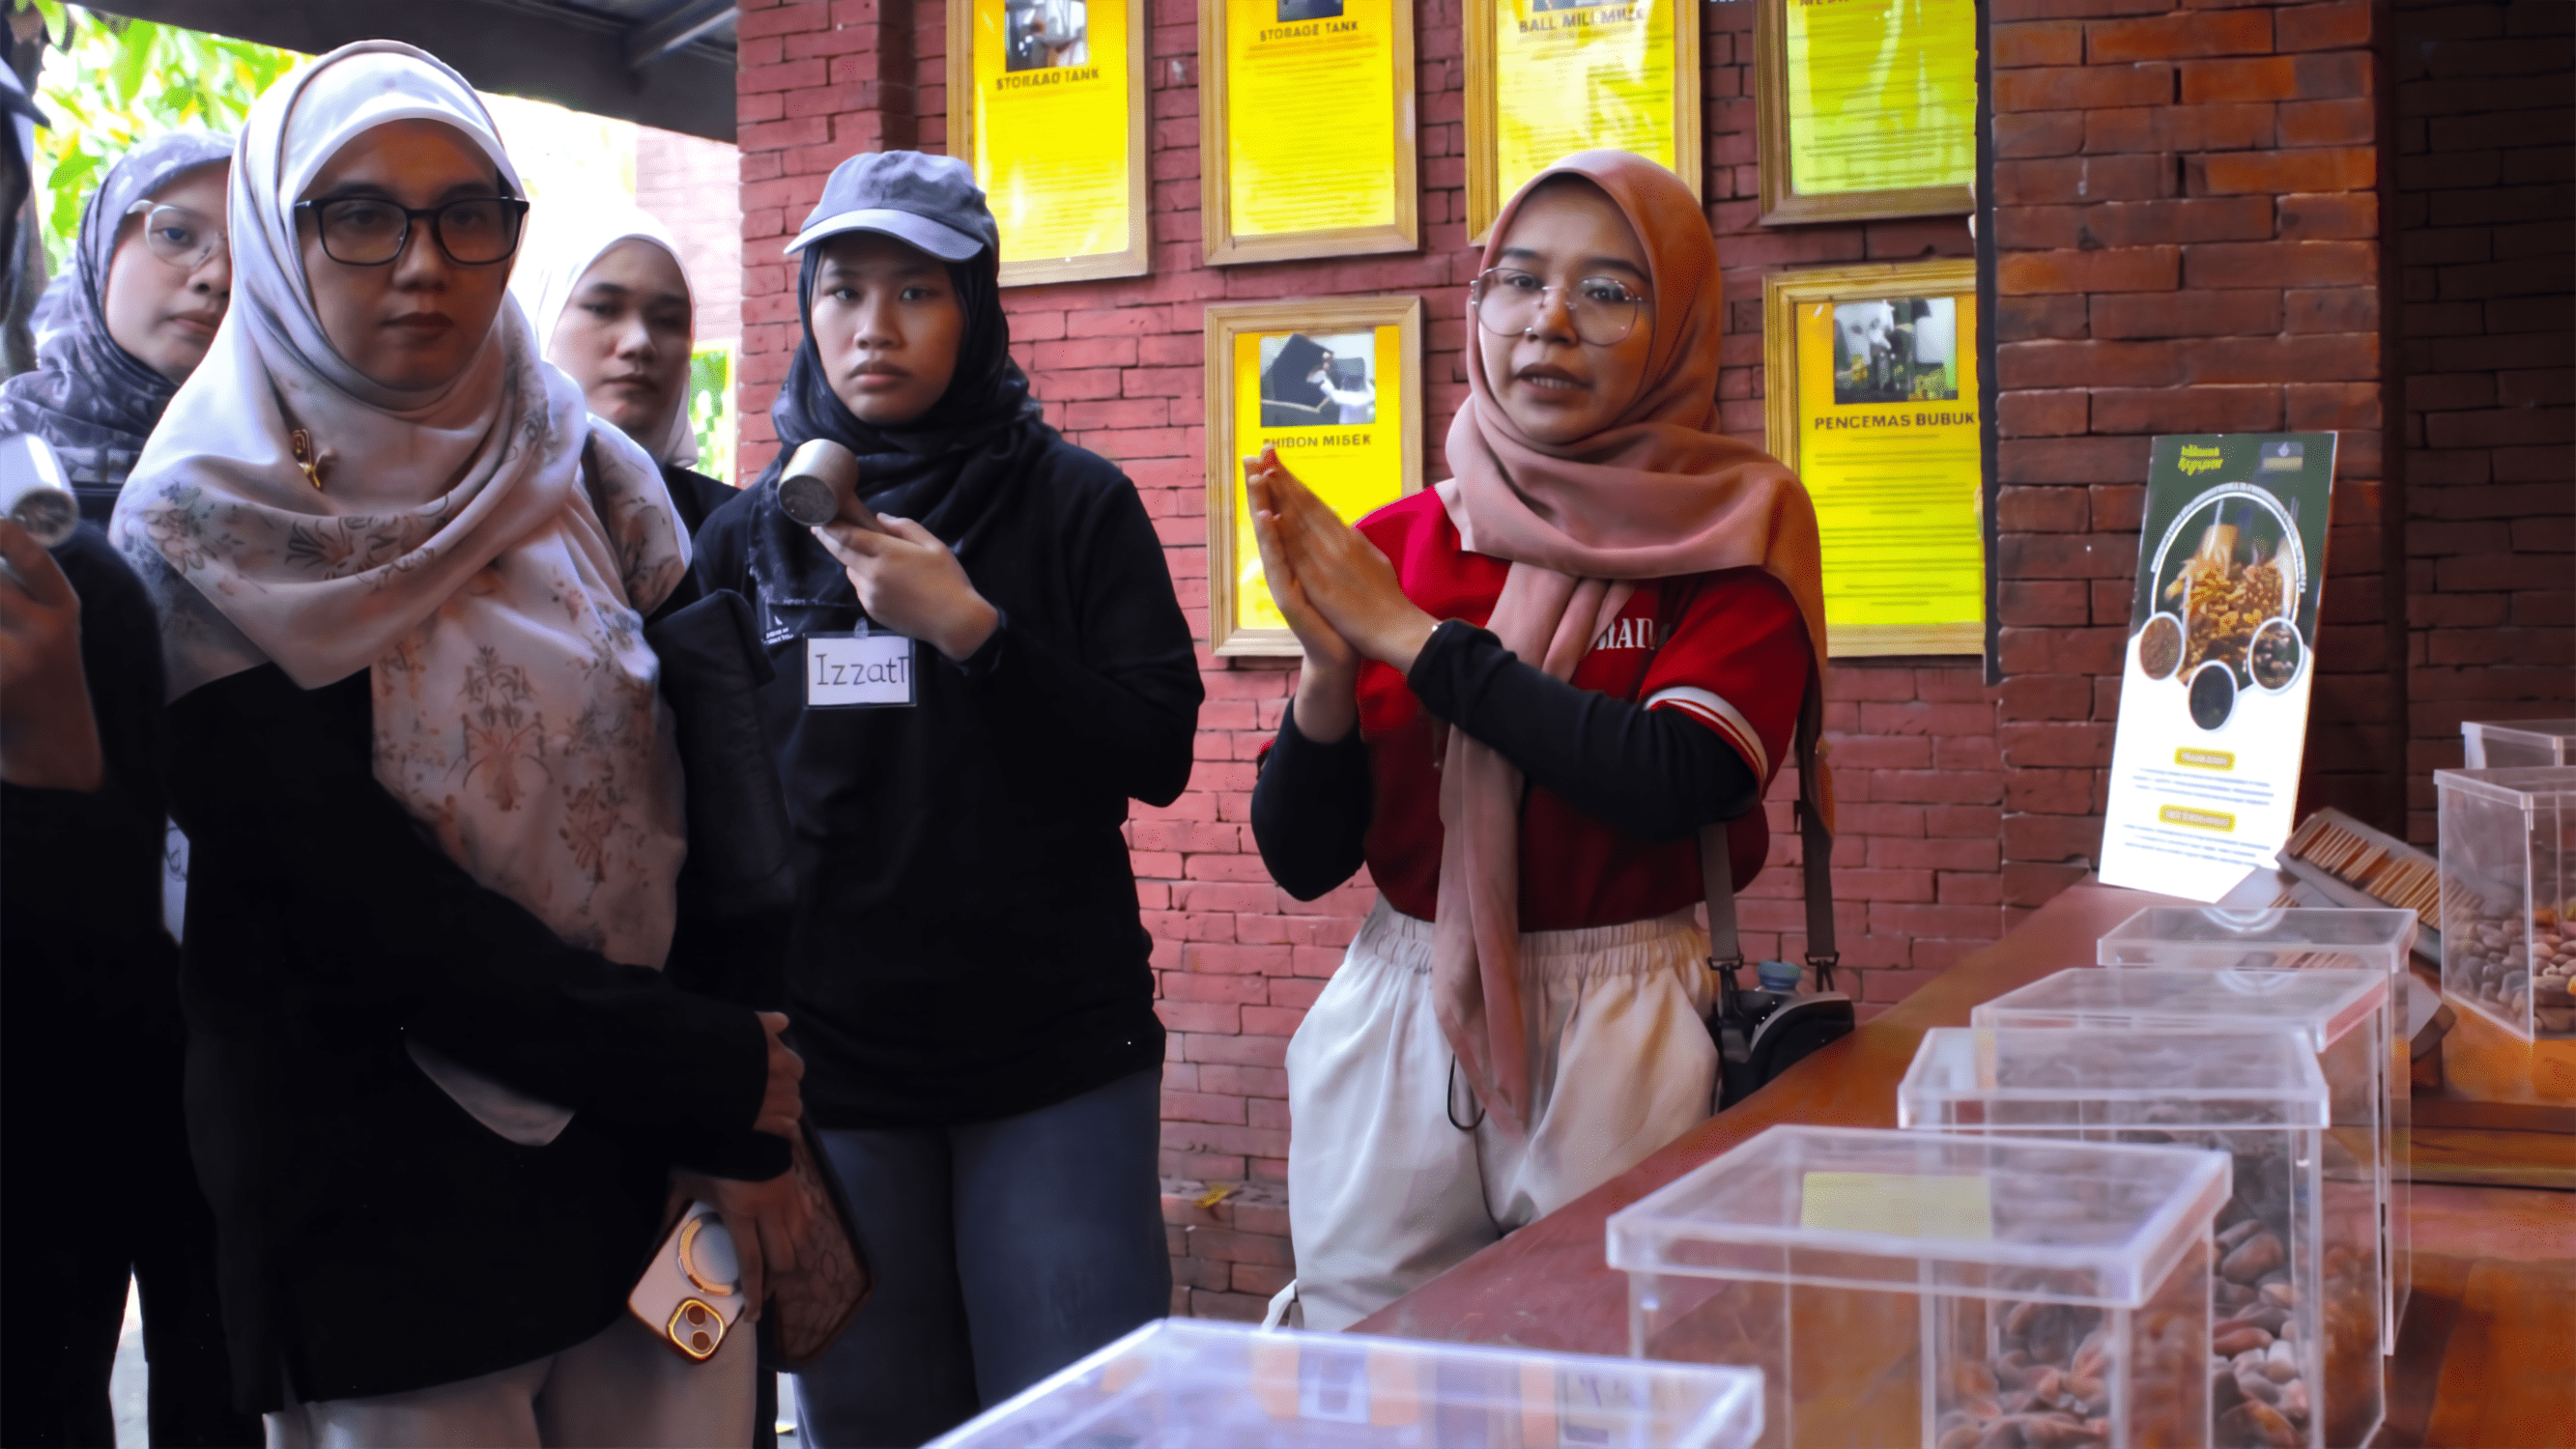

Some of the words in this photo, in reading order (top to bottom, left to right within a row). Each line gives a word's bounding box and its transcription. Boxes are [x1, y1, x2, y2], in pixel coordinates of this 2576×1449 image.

[1325, 20, 1359, 34] TANK
[1519, 15, 1557, 33] BALL
[1815, 413, 1911, 430] PENCEMAS
[1915, 412, 1975, 427] BUBUK
